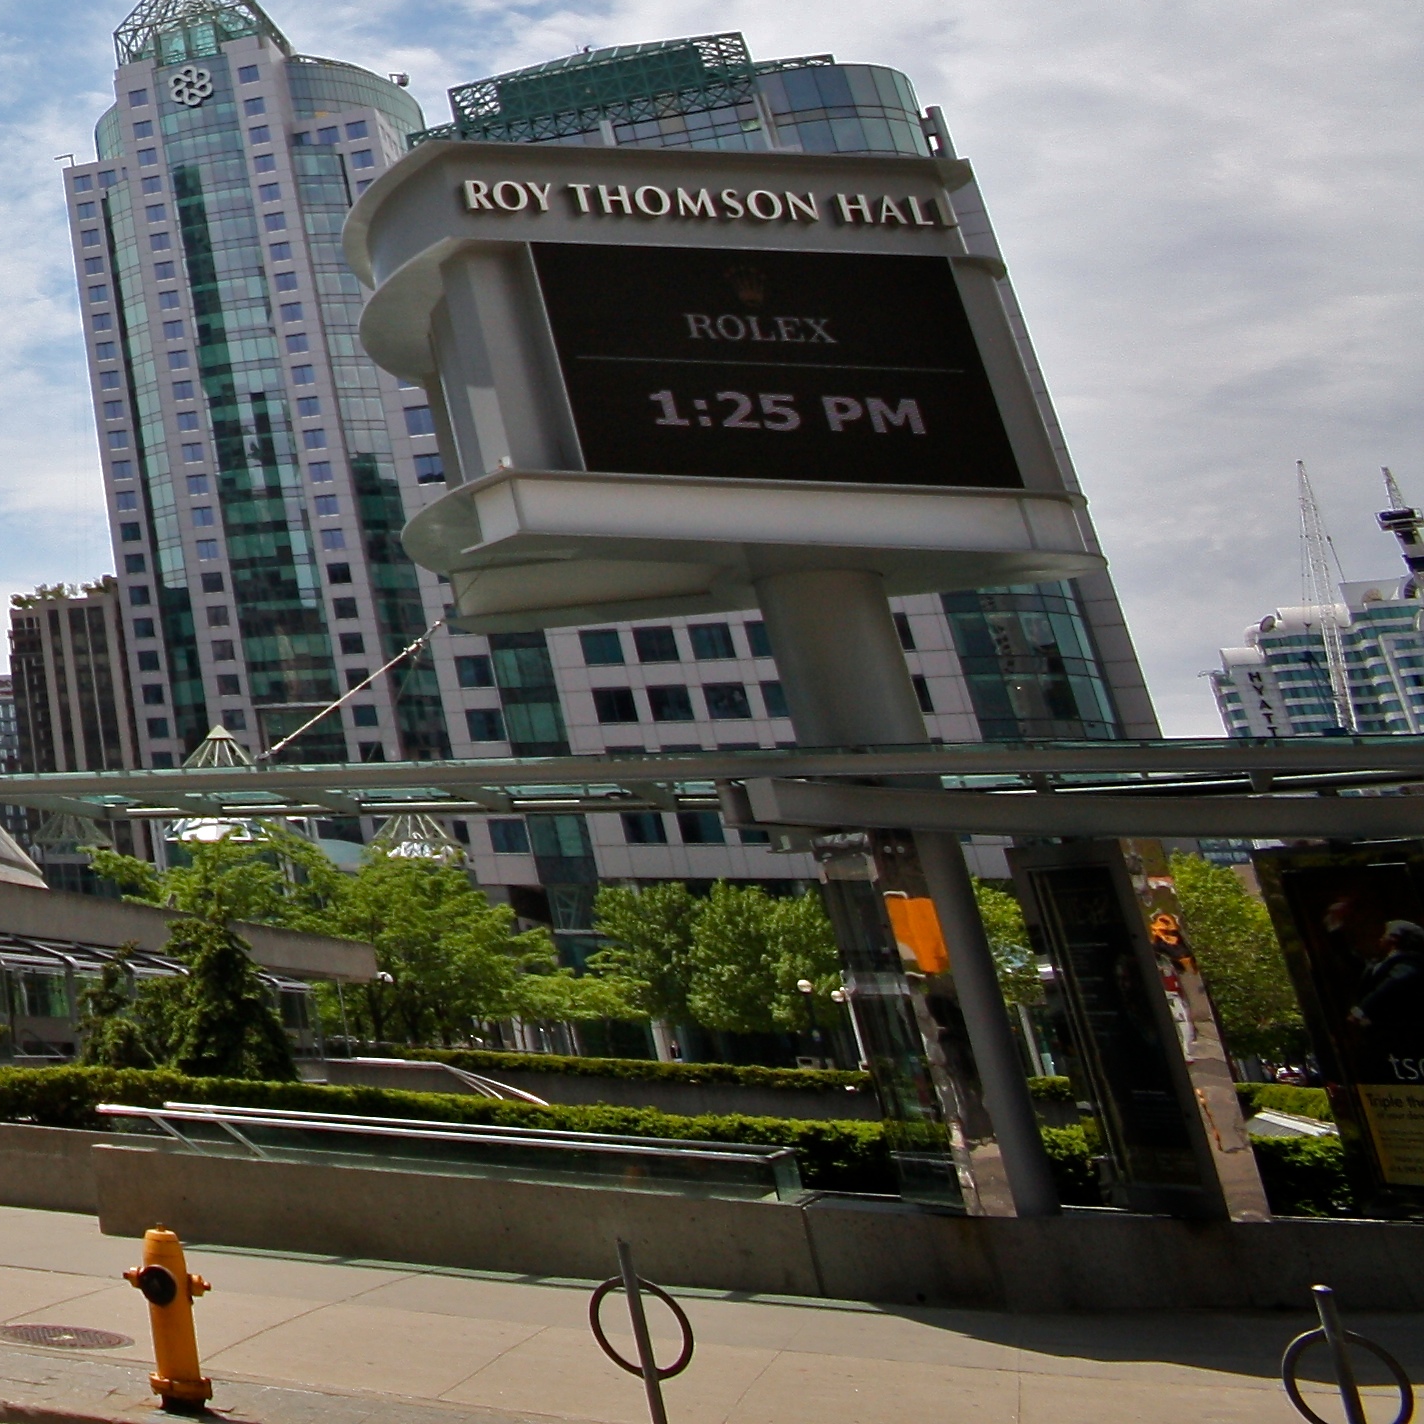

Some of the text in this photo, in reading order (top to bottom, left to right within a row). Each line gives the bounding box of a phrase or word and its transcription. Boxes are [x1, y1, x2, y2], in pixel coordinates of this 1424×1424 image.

[464, 179, 552, 212] ROY
[568, 183, 821, 223] THOMSON
[684, 312, 839, 344] ROLEX
[648, 389, 927, 435] 1:25 PM
[1247, 671, 1279, 737] HYATT
